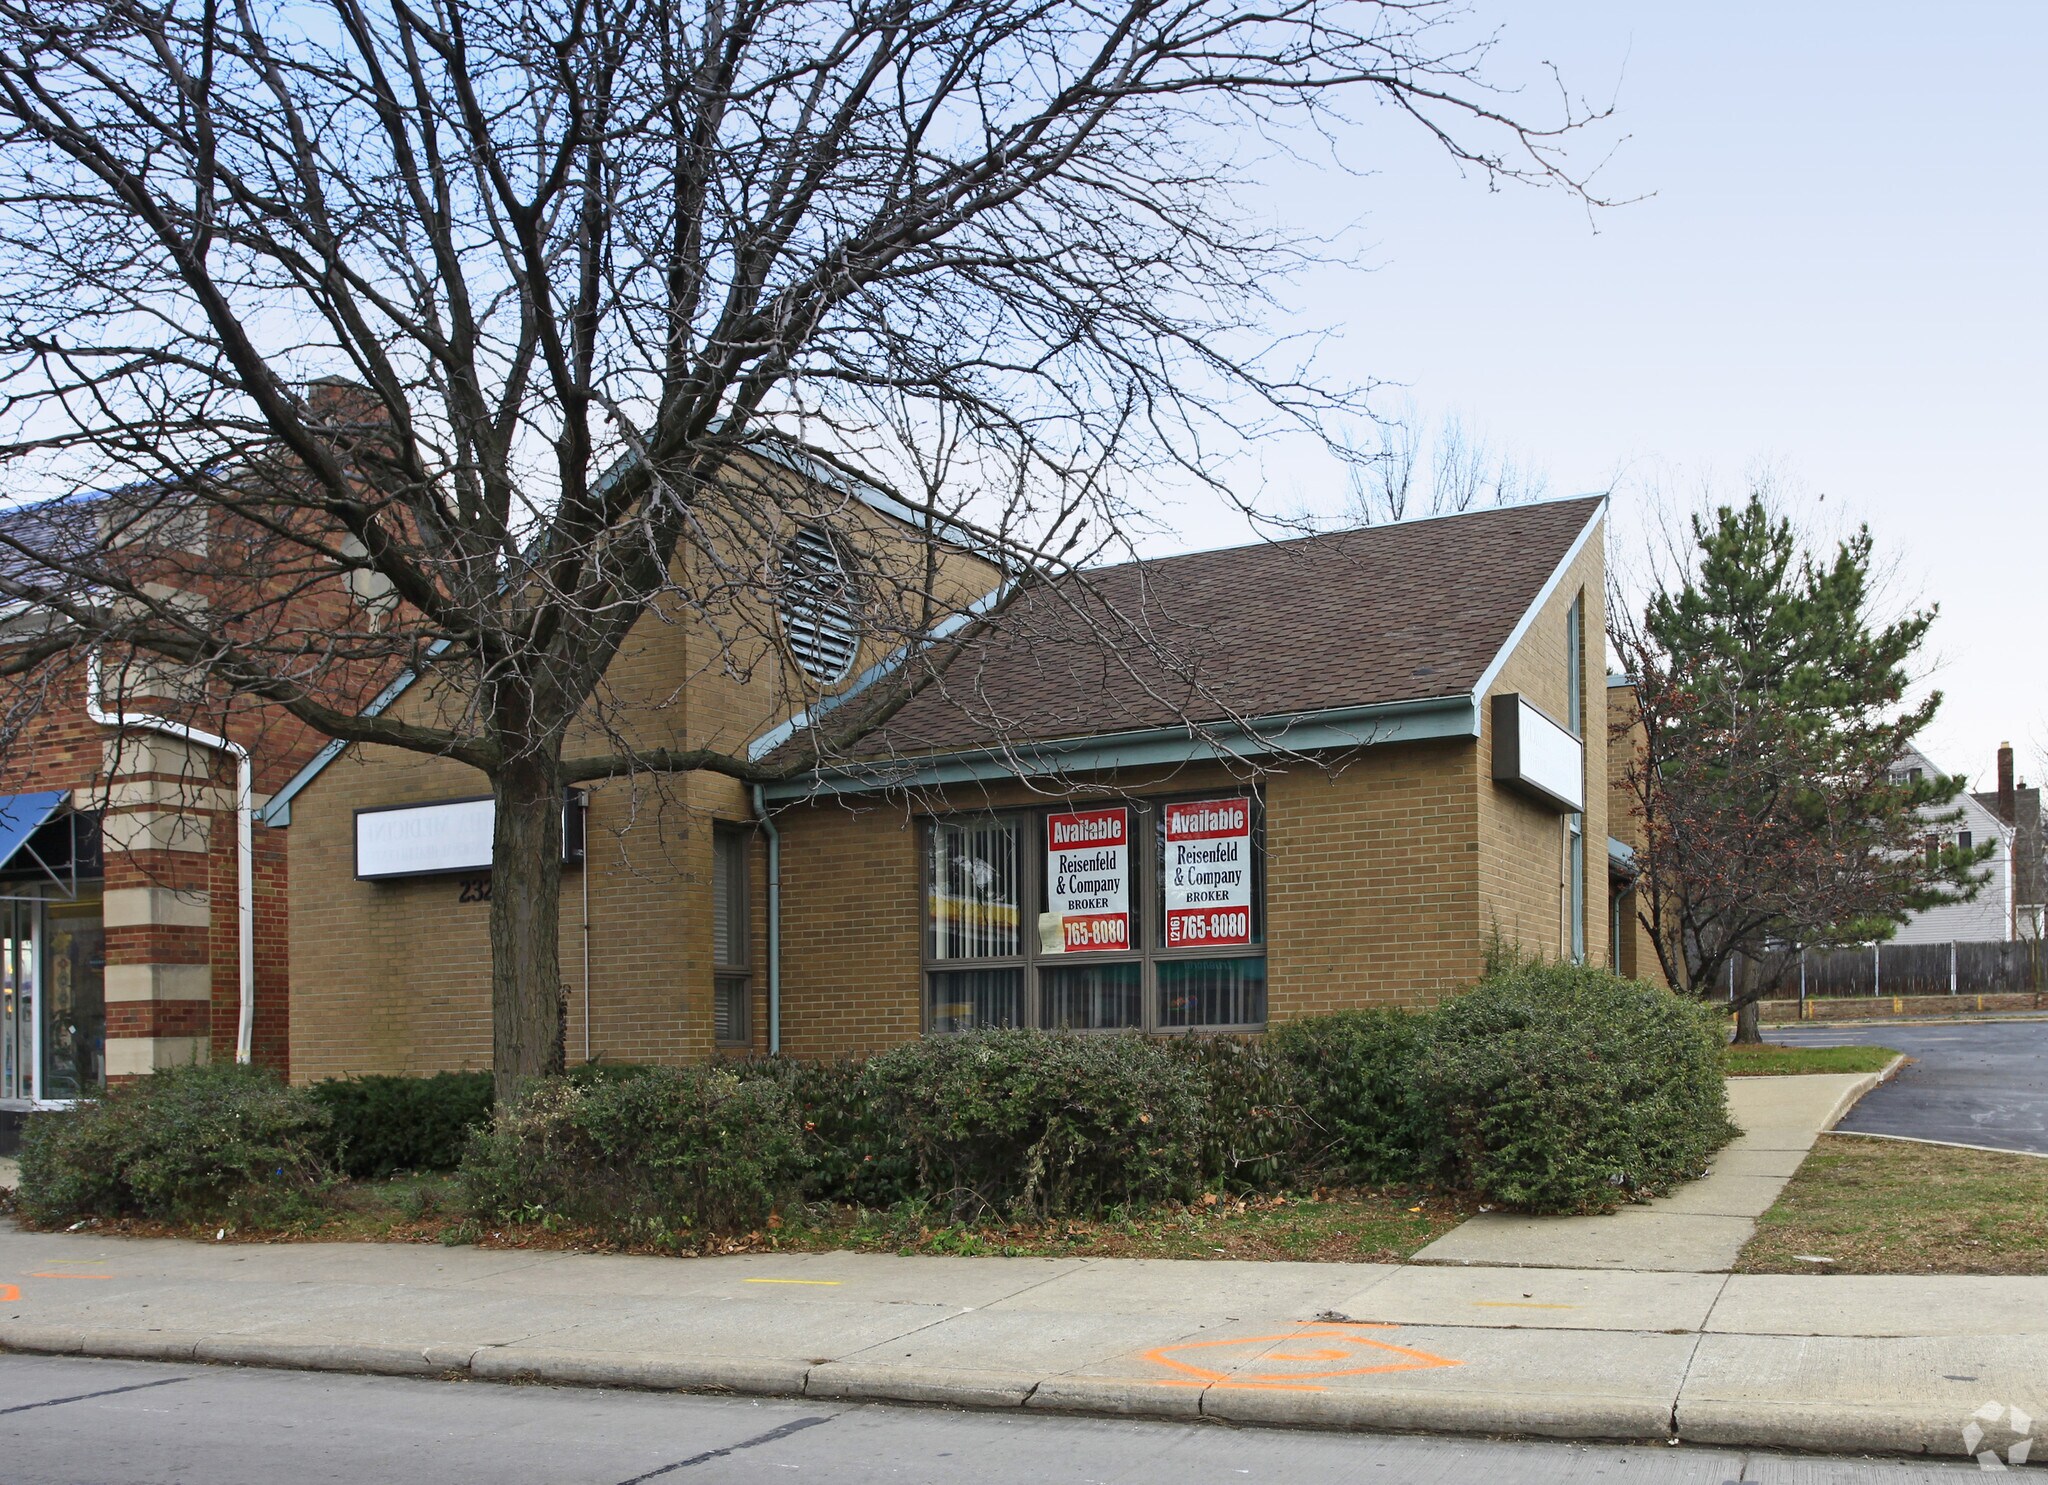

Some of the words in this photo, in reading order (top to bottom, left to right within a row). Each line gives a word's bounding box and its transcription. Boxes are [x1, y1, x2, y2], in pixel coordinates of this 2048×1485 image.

[1053, 817, 1122, 844] Available
[1171, 809, 1244, 834] Available
[1059, 851, 1117, 874] Reisenfeld
[1177, 841, 1238, 865] Reisenfeld
[1056, 875, 1066, 895] &
[1069, 874, 1121, 896] Company
[1174, 867, 1185, 886] &
[1188, 867, 1242, 888] Company
[1068, 898, 1109, 910] BROKER
[1186, 890, 1229, 903] BROKER
[1065, 919, 1125, 946] 765-8080
[1170, 916, 1181, 942] (216)
[1181, 912, 1246, 940] 765-8080
